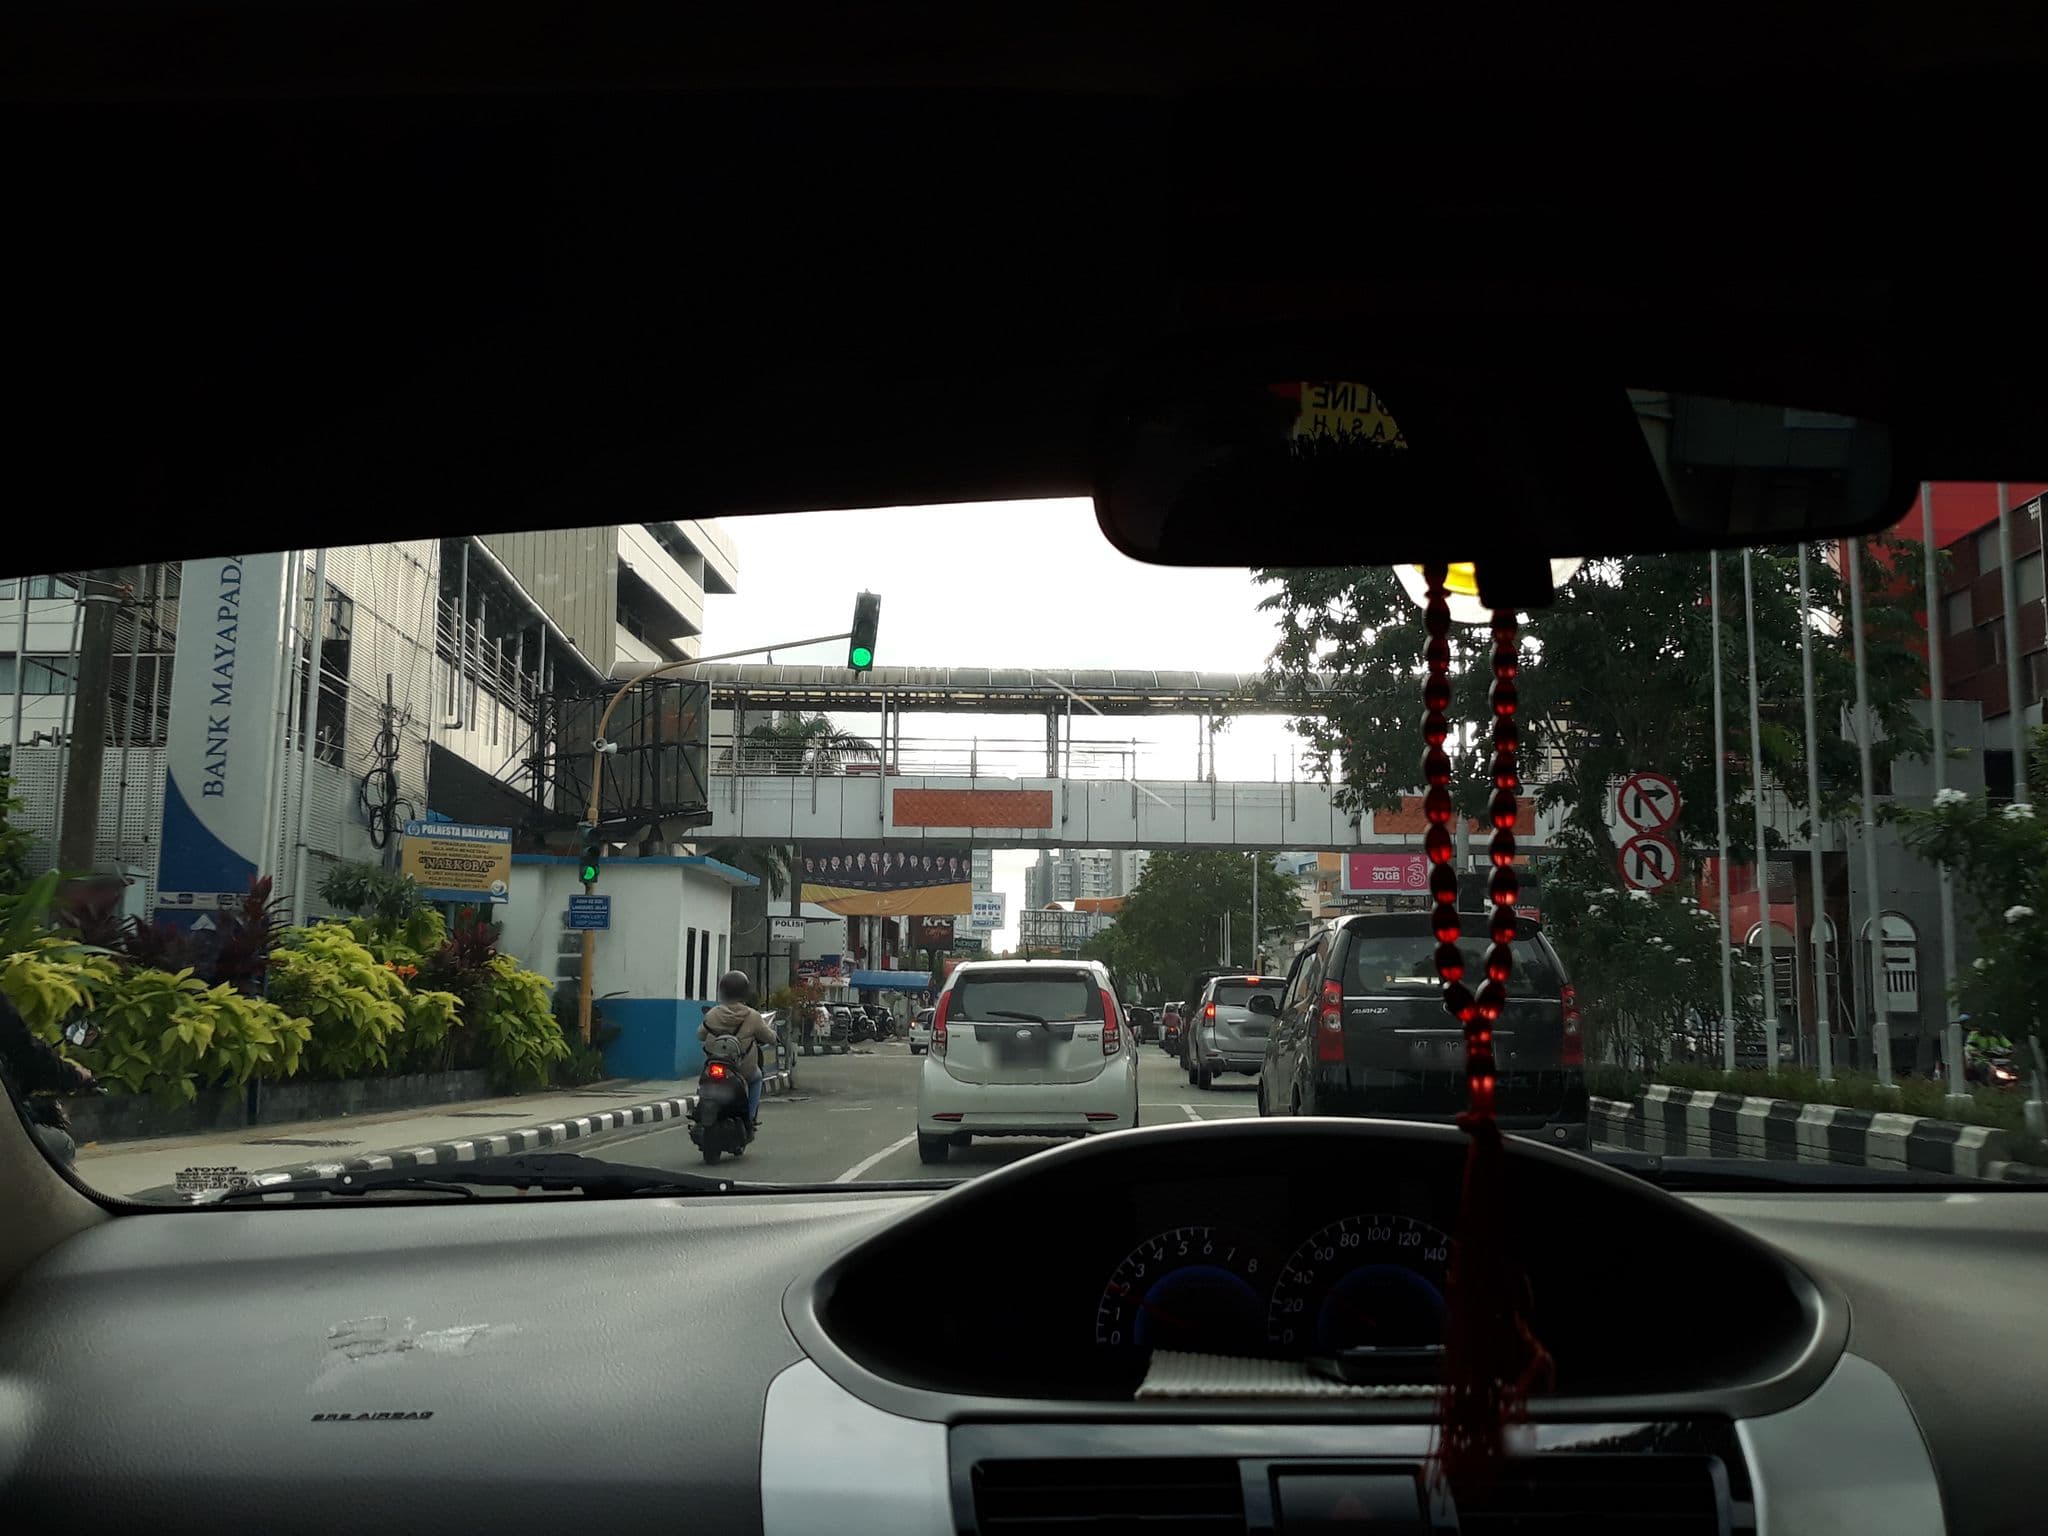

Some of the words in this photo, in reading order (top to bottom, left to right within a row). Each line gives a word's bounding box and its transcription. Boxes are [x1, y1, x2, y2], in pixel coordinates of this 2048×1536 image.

[203, 715, 230, 798] BANK
[775, 919, 804, 928] POLISI
[923, 916, 951, 927] KFC
[1177, 1241, 1190, 1256] 5
[1313, 1247, 1336, 1262] 60
[1339, 1232, 1362, 1248] 80
[1367, 1226, 1393, 1242] 100
[1397, 1231, 1423, 1247] 120
[1423, 1246, 1449, 1262] 140
